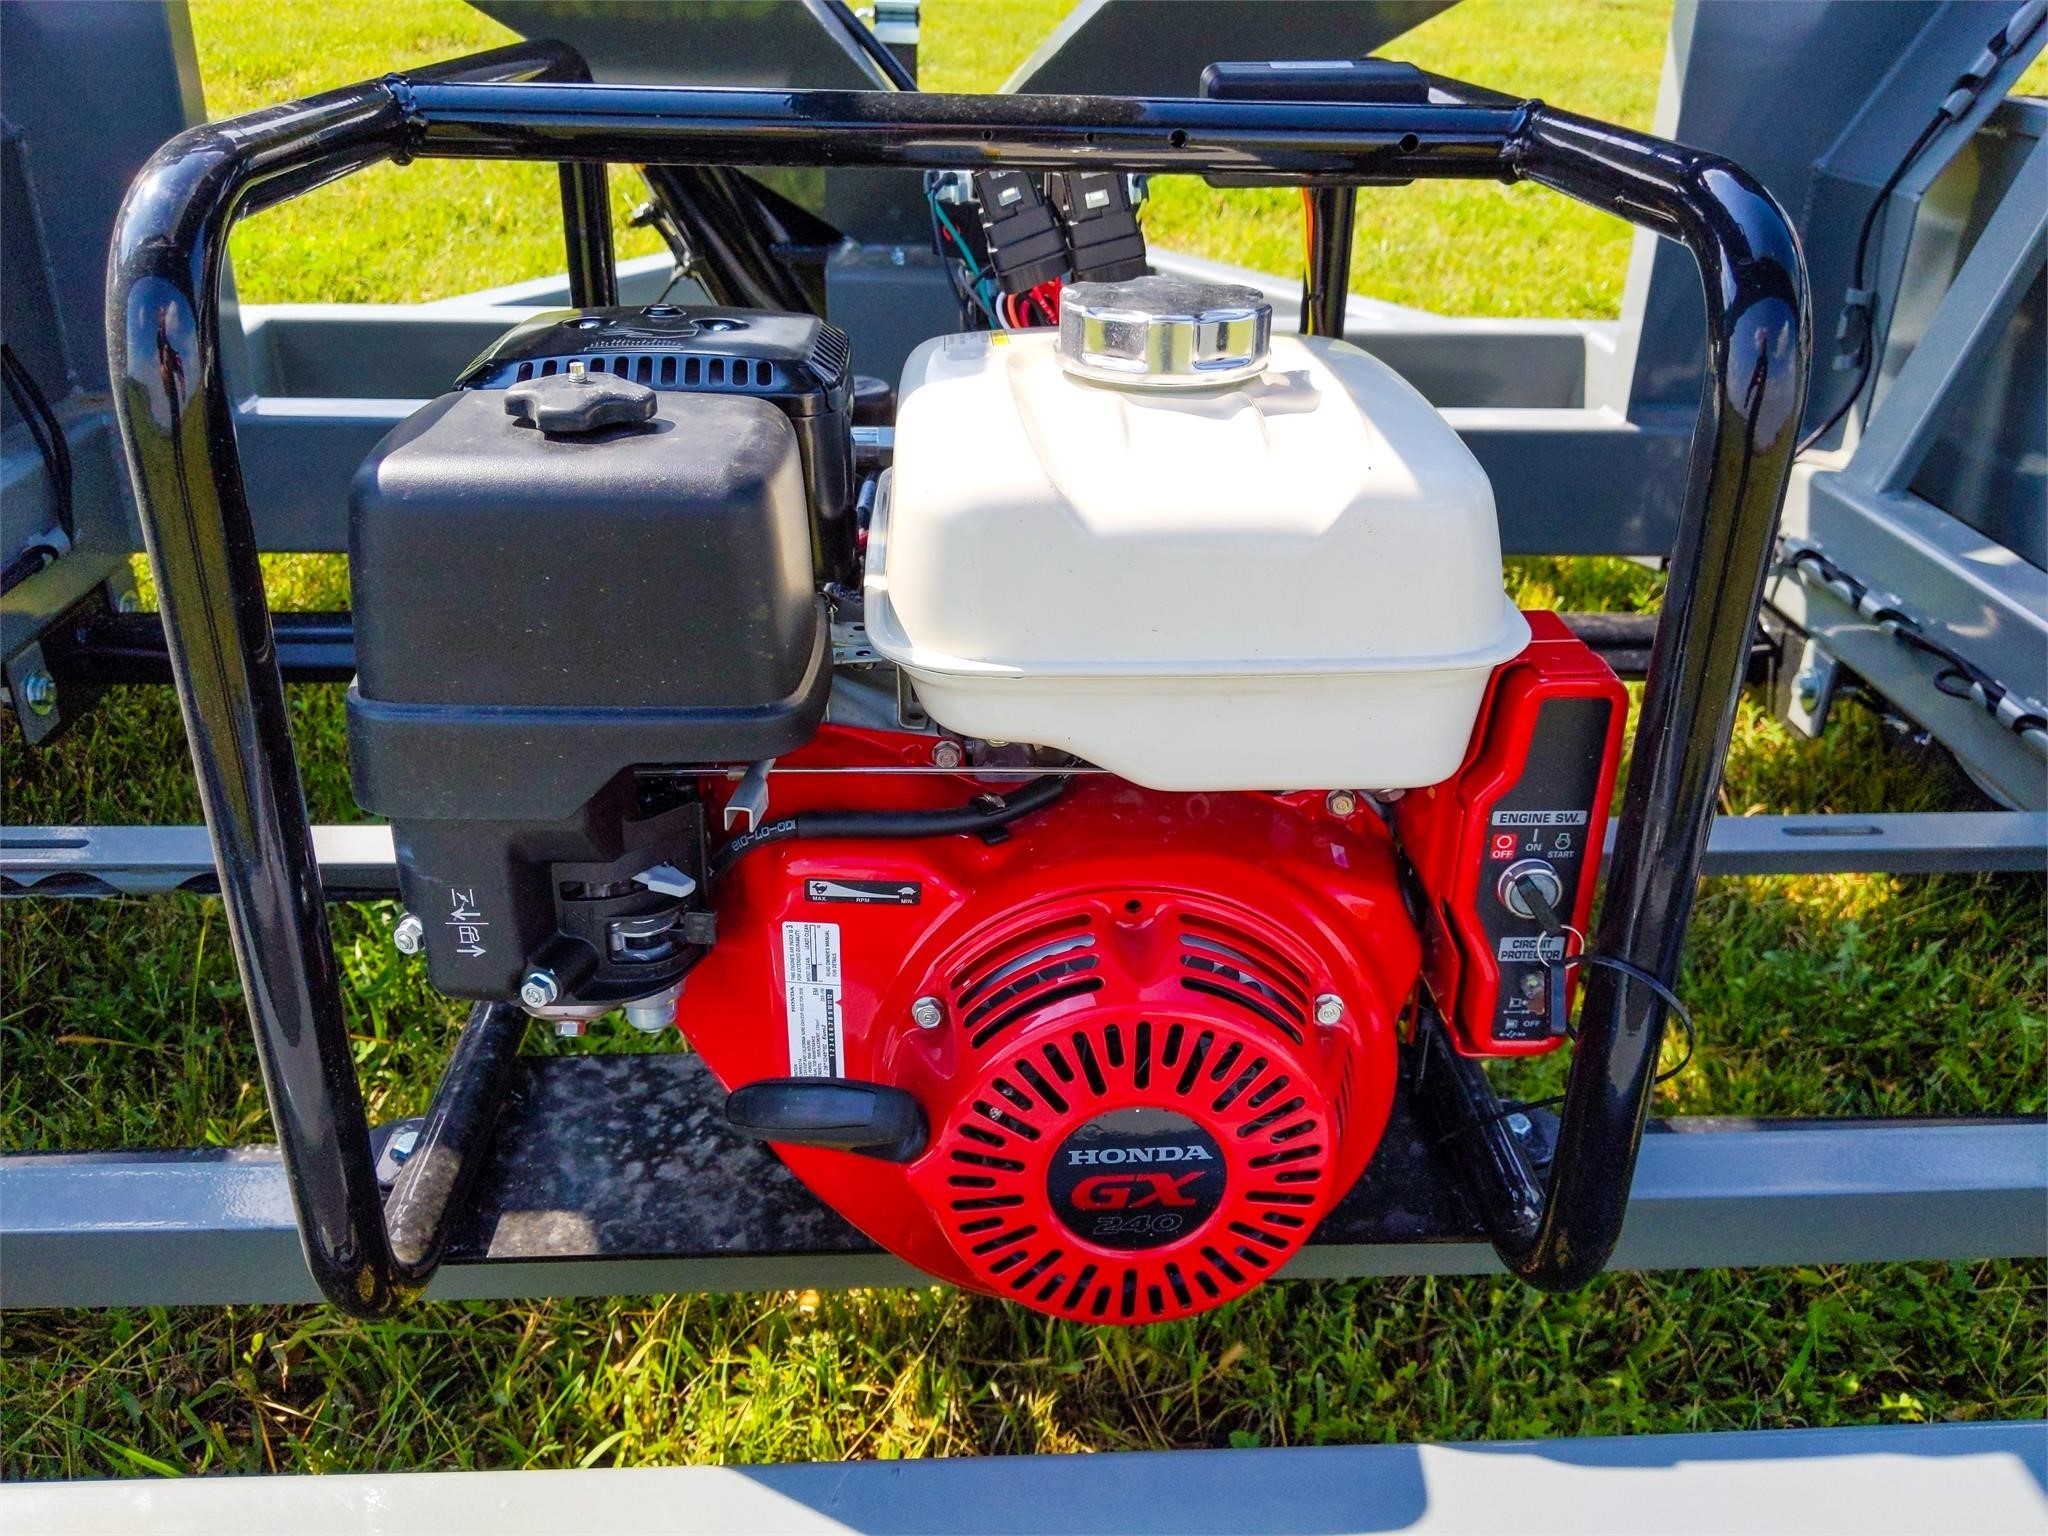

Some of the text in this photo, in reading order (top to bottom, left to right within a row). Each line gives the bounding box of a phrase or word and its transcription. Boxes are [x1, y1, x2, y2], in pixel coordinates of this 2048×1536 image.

[1499, 812, 1580, 824] ENGINE SW.
[1525, 843, 1542, 852] ON
[1492, 850, 1514, 858] OFF
[1547, 850, 1574, 858] START
[1068, 1146, 1214, 1165] HONDA
[1070, 1171, 1206, 1210] GX
[1092, 1213, 1184, 1235] 240
